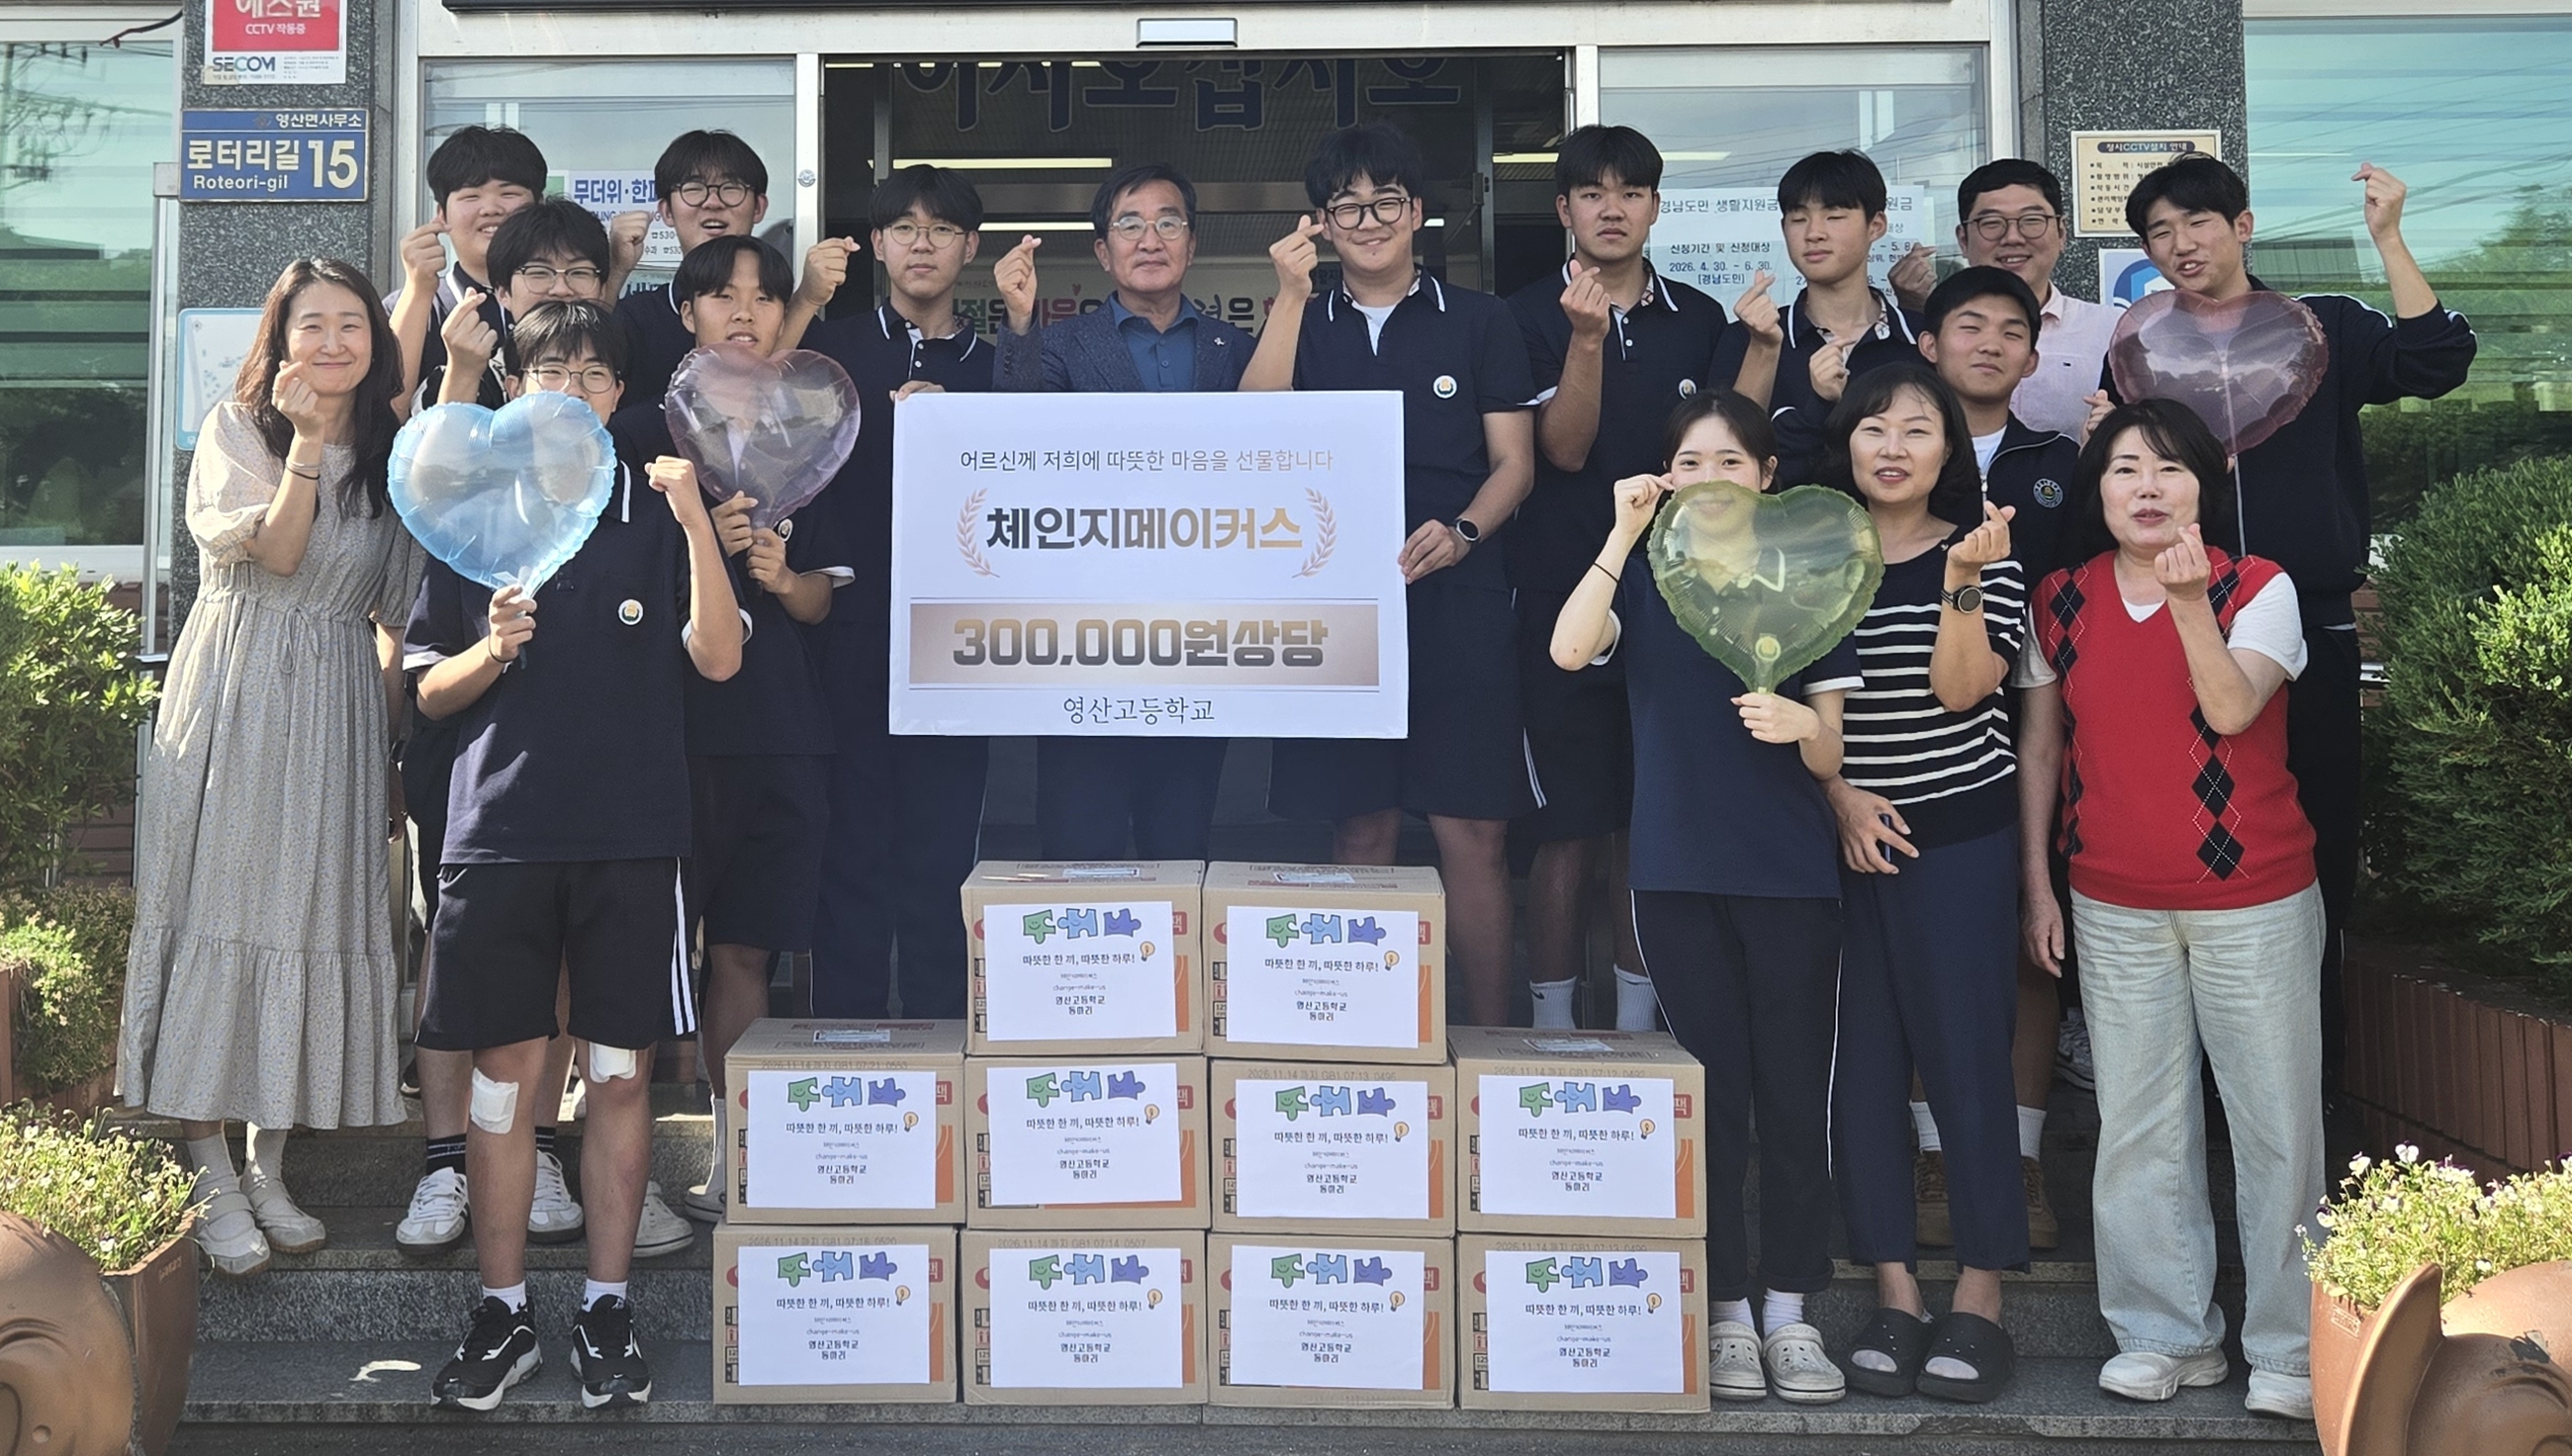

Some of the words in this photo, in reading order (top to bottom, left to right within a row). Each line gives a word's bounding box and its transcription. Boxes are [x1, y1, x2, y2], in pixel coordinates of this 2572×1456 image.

[245, 24, 275, 35] CCTV
[213, 56, 276, 72] SECOM
[275, 114, 362, 129] 영산면사무소
[187, 139, 300, 171] 로터리길
[308, 139, 358, 189] 15
[193, 174, 288, 192] Roteori-gil
[1660, 200, 1709, 213] 경남도민
[1716, 199, 1779, 213] 생활지원금
[1886, 197, 1912, 211] 원금
[1671, 243, 1710, 254] 신청기간
[1731, 242, 1770, 253] 신청대상
[1669, 261, 1697, 272] 2026.
[1699, 261, 1708, 272] 4.
[1713, 261, 1728, 272] 30.
[960, 449, 1037, 473] 어르신께
[1043, 449, 1101, 473] 저희에
[1106, 449, 1165, 473] 따뜻한
[1171, 449, 1230, 473] 마음을
[1235, 448, 1333, 473] 선물합니다
[985, 506, 1304, 550] 체인지메이커스
[952, 618, 1329, 668] 300,000원상당
[1062, 695, 1216, 726] 영산고등학교
[1023, 955, 1051, 965] 따뜻한
[1055, 955, 1062, 965] 한
[1081, 954, 1110, 964] 따뜻한
[1112, 954, 1135, 963] 하루!
[1265, 958, 1293, 969] 따뜻한
[1297, 959, 1305, 969] 한
[1322, 960, 1352, 971] 따뜻한
[1355, 961, 1378, 972] 하루!
[786, 1123, 814, 1134] 따뜻한
[815, 1123, 826, 1134] 한
[842, 1123, 873, 1134] 따뜻한
[873, 1123, 897, 1134] 하루!
[1027, 1118, 1055, 1130] 따뜻한
[1058, 1118, 1066, 1129] 한
[1085, 1117, 1113, 1129] 따뜻한
[1117, 1117, 1139, 1128] 하루!
[1274, 1132, 1303, 1142] 따뜻한
[1307, 1132, 1315, 1142] 한
[1333, 1133, 1362, 1143] 따뜻한
[1365, 1133, 1388, 1143] 하루!
[1518, 1129, 1547, 1139] 따뜻한
[1551, 1129, 1560, 1139] 한
[1579, 1130, 1608, 1140] 따뜻한
[1610, 1130, 1634, 1141] 하루!
[777, 1298, 805, 1310] 따뜻한
[808, 1298, 817, 1309] 한
[836, 1298, 864, 1309] 따뜻한
[867, 1297, 889, 1309] 하루!
[1028, 1301, 1056, 1312] 따뜻한
[1060, 1301, 1068, 1312] 한
[1087, 1301, 1116, 1312] 따뜻한
[1119, 1301, 1142, 1312] 하루!
[1269, 1299, 1298, 1311] 따뜻한
[1302, 1300, 1311, 1311] 한
[1329, 1301, 1357, 1313] 따뜻한
[1361, 1302, 1383, 1314] 하루!
[1525, 1304, 1555, 1316] 따뜻한
[1557, 1305, 1567, 1316] 한
[1586, 1305, 1614, 1316] 따뜻한
[1617, 1305, 1641, 1316] 하루!
